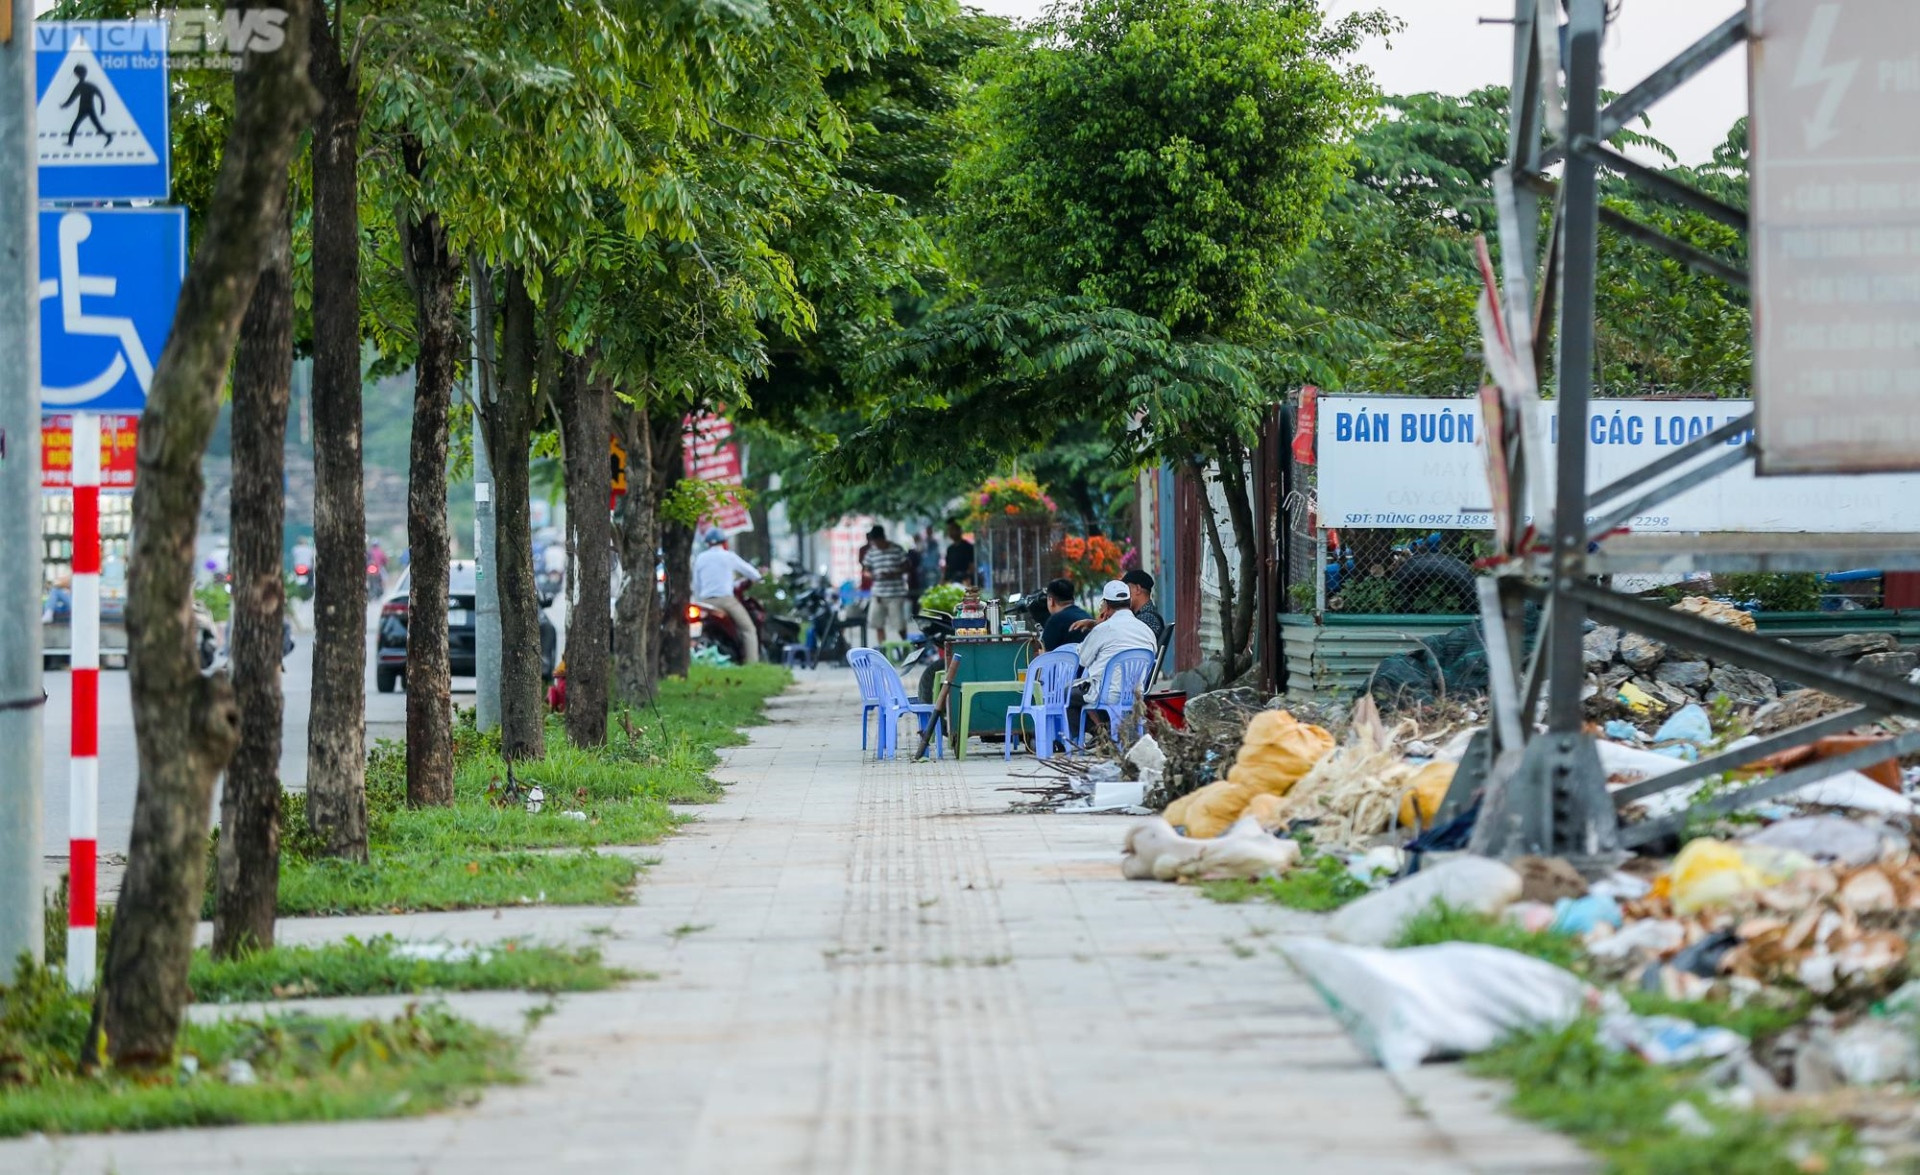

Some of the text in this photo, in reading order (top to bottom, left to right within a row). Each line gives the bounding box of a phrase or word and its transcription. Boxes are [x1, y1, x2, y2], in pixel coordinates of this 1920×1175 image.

[1336, 406, 1390, 443] BÁN
[1401, 407, 1474, 444] BUÔN
[1590, 409, 1644, 445] CÁC
[1344, 512, 1373, 525] SĐT:
[1376, 511, 1416, 525] DŨNG
[1418, 513, 1453, 525] 0987
[1456, 514, 1489, 526] 1888
[1634, 516, 1670, 527] 2298
